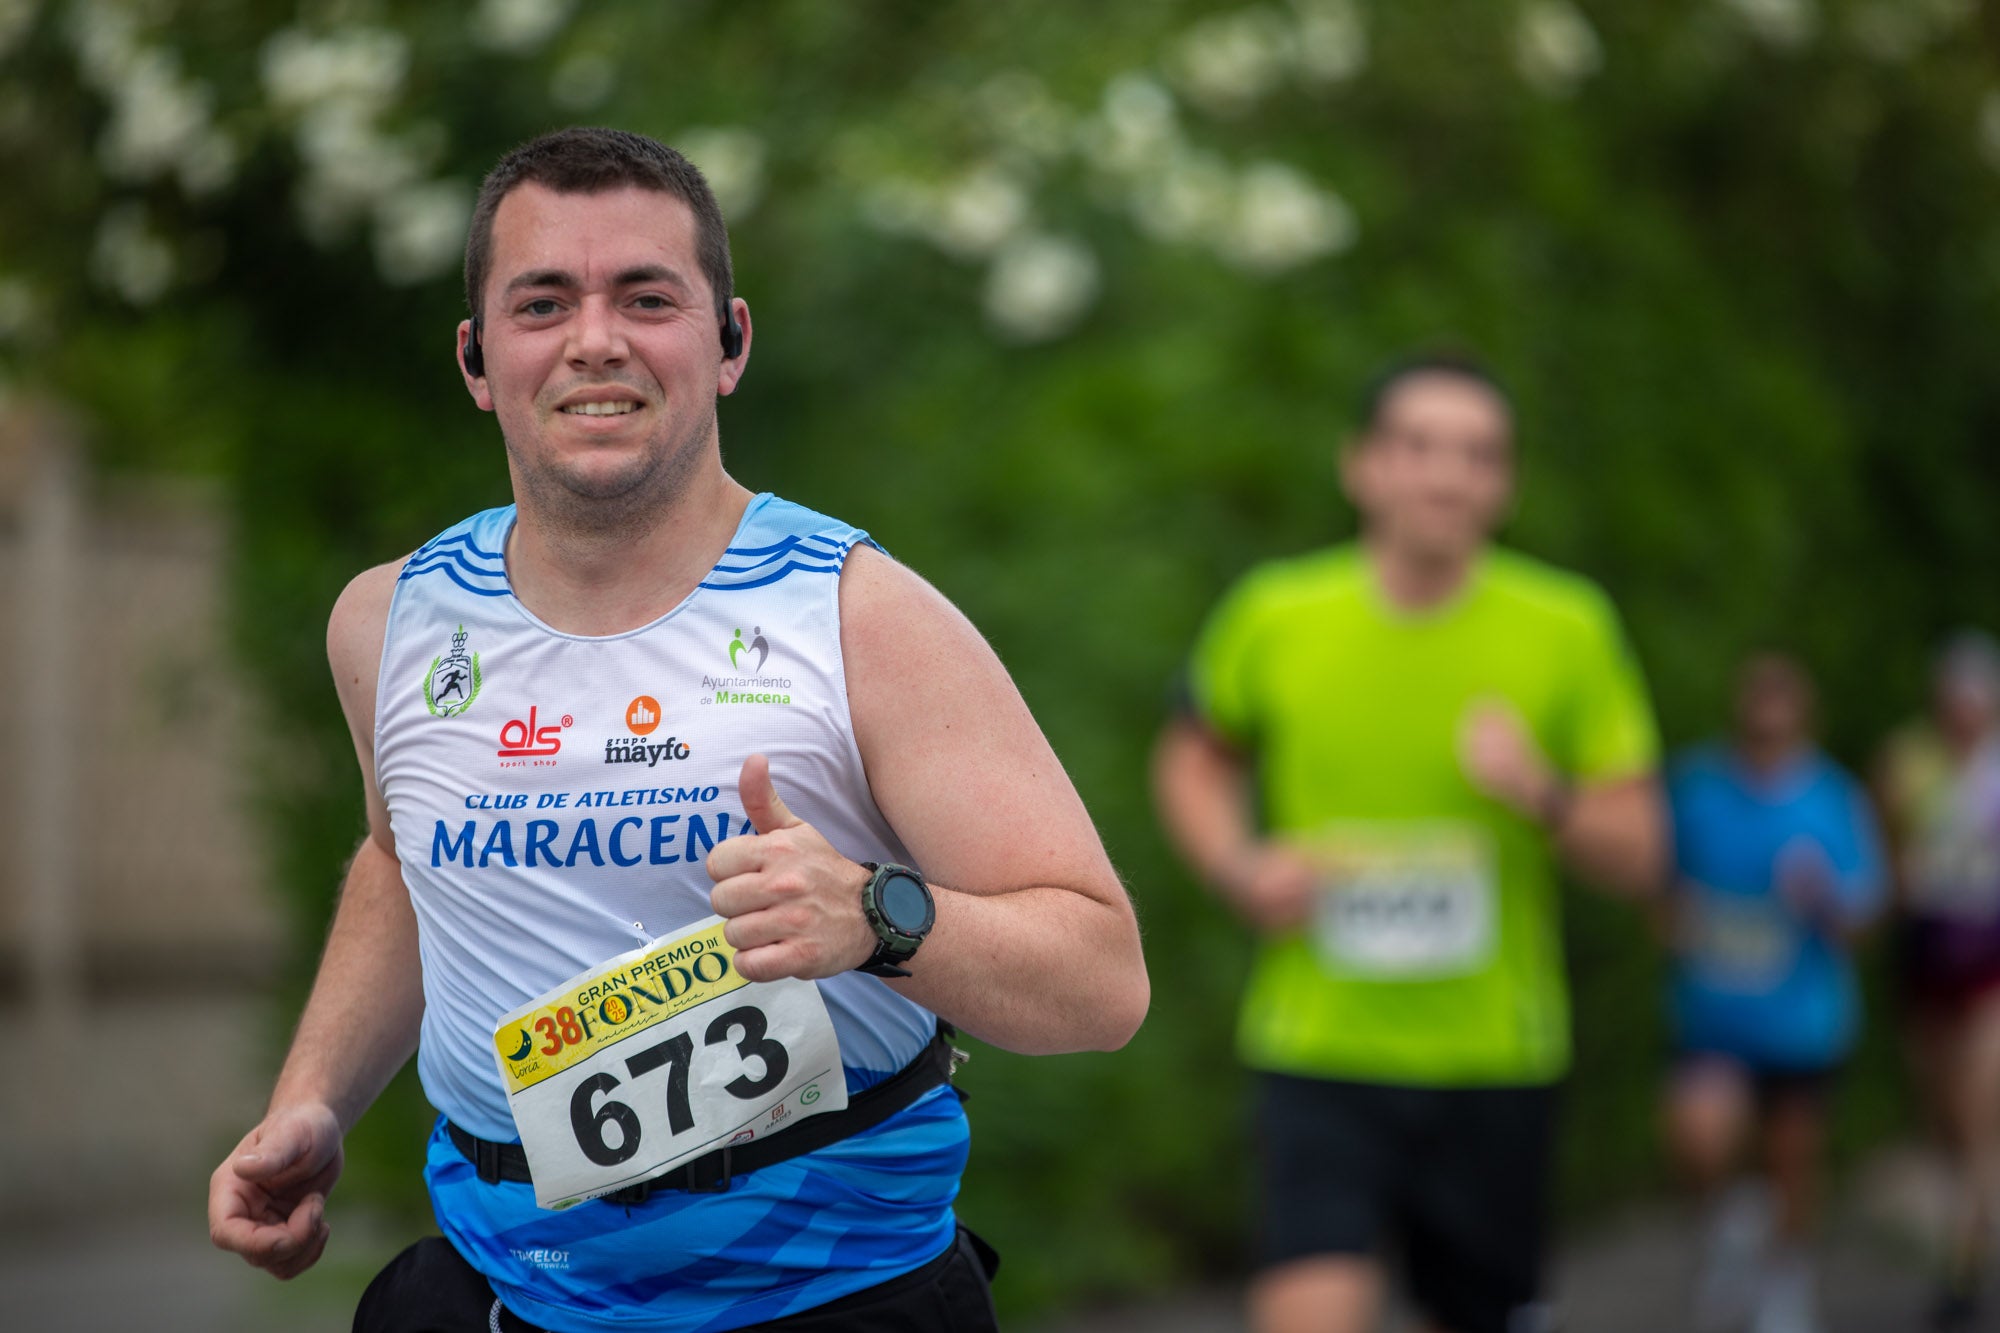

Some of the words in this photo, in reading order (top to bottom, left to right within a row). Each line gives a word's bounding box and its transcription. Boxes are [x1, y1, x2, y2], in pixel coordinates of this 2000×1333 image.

[701, 675, 792, 691] Ayuntamiento
[700, 696, 712, 705] de
[715, 690, 791, 704] Maracena
[606, 737, 647, 747] grupo
[604, 737, 690, 767] mayfo
[533, 760, 557, 768] shop
[465, 794, 528, 810] CLUB
[536, 793, 570, 809] DE
[575, 786, 719, 809] ATLETISMO
[578, 973, 628, 1006] GRAN
[630, 940, 704, 981] PREMIO
[535, 1006, 583, 1056] 38
[576, 951, 729, 1041] FONDO
[604, 999, 617, 1012] 20
[612, 1009, 626, 1022] 25
[508, 1061, 540, 1080] Lorca
[570, 1005, 789, 1167] 673
